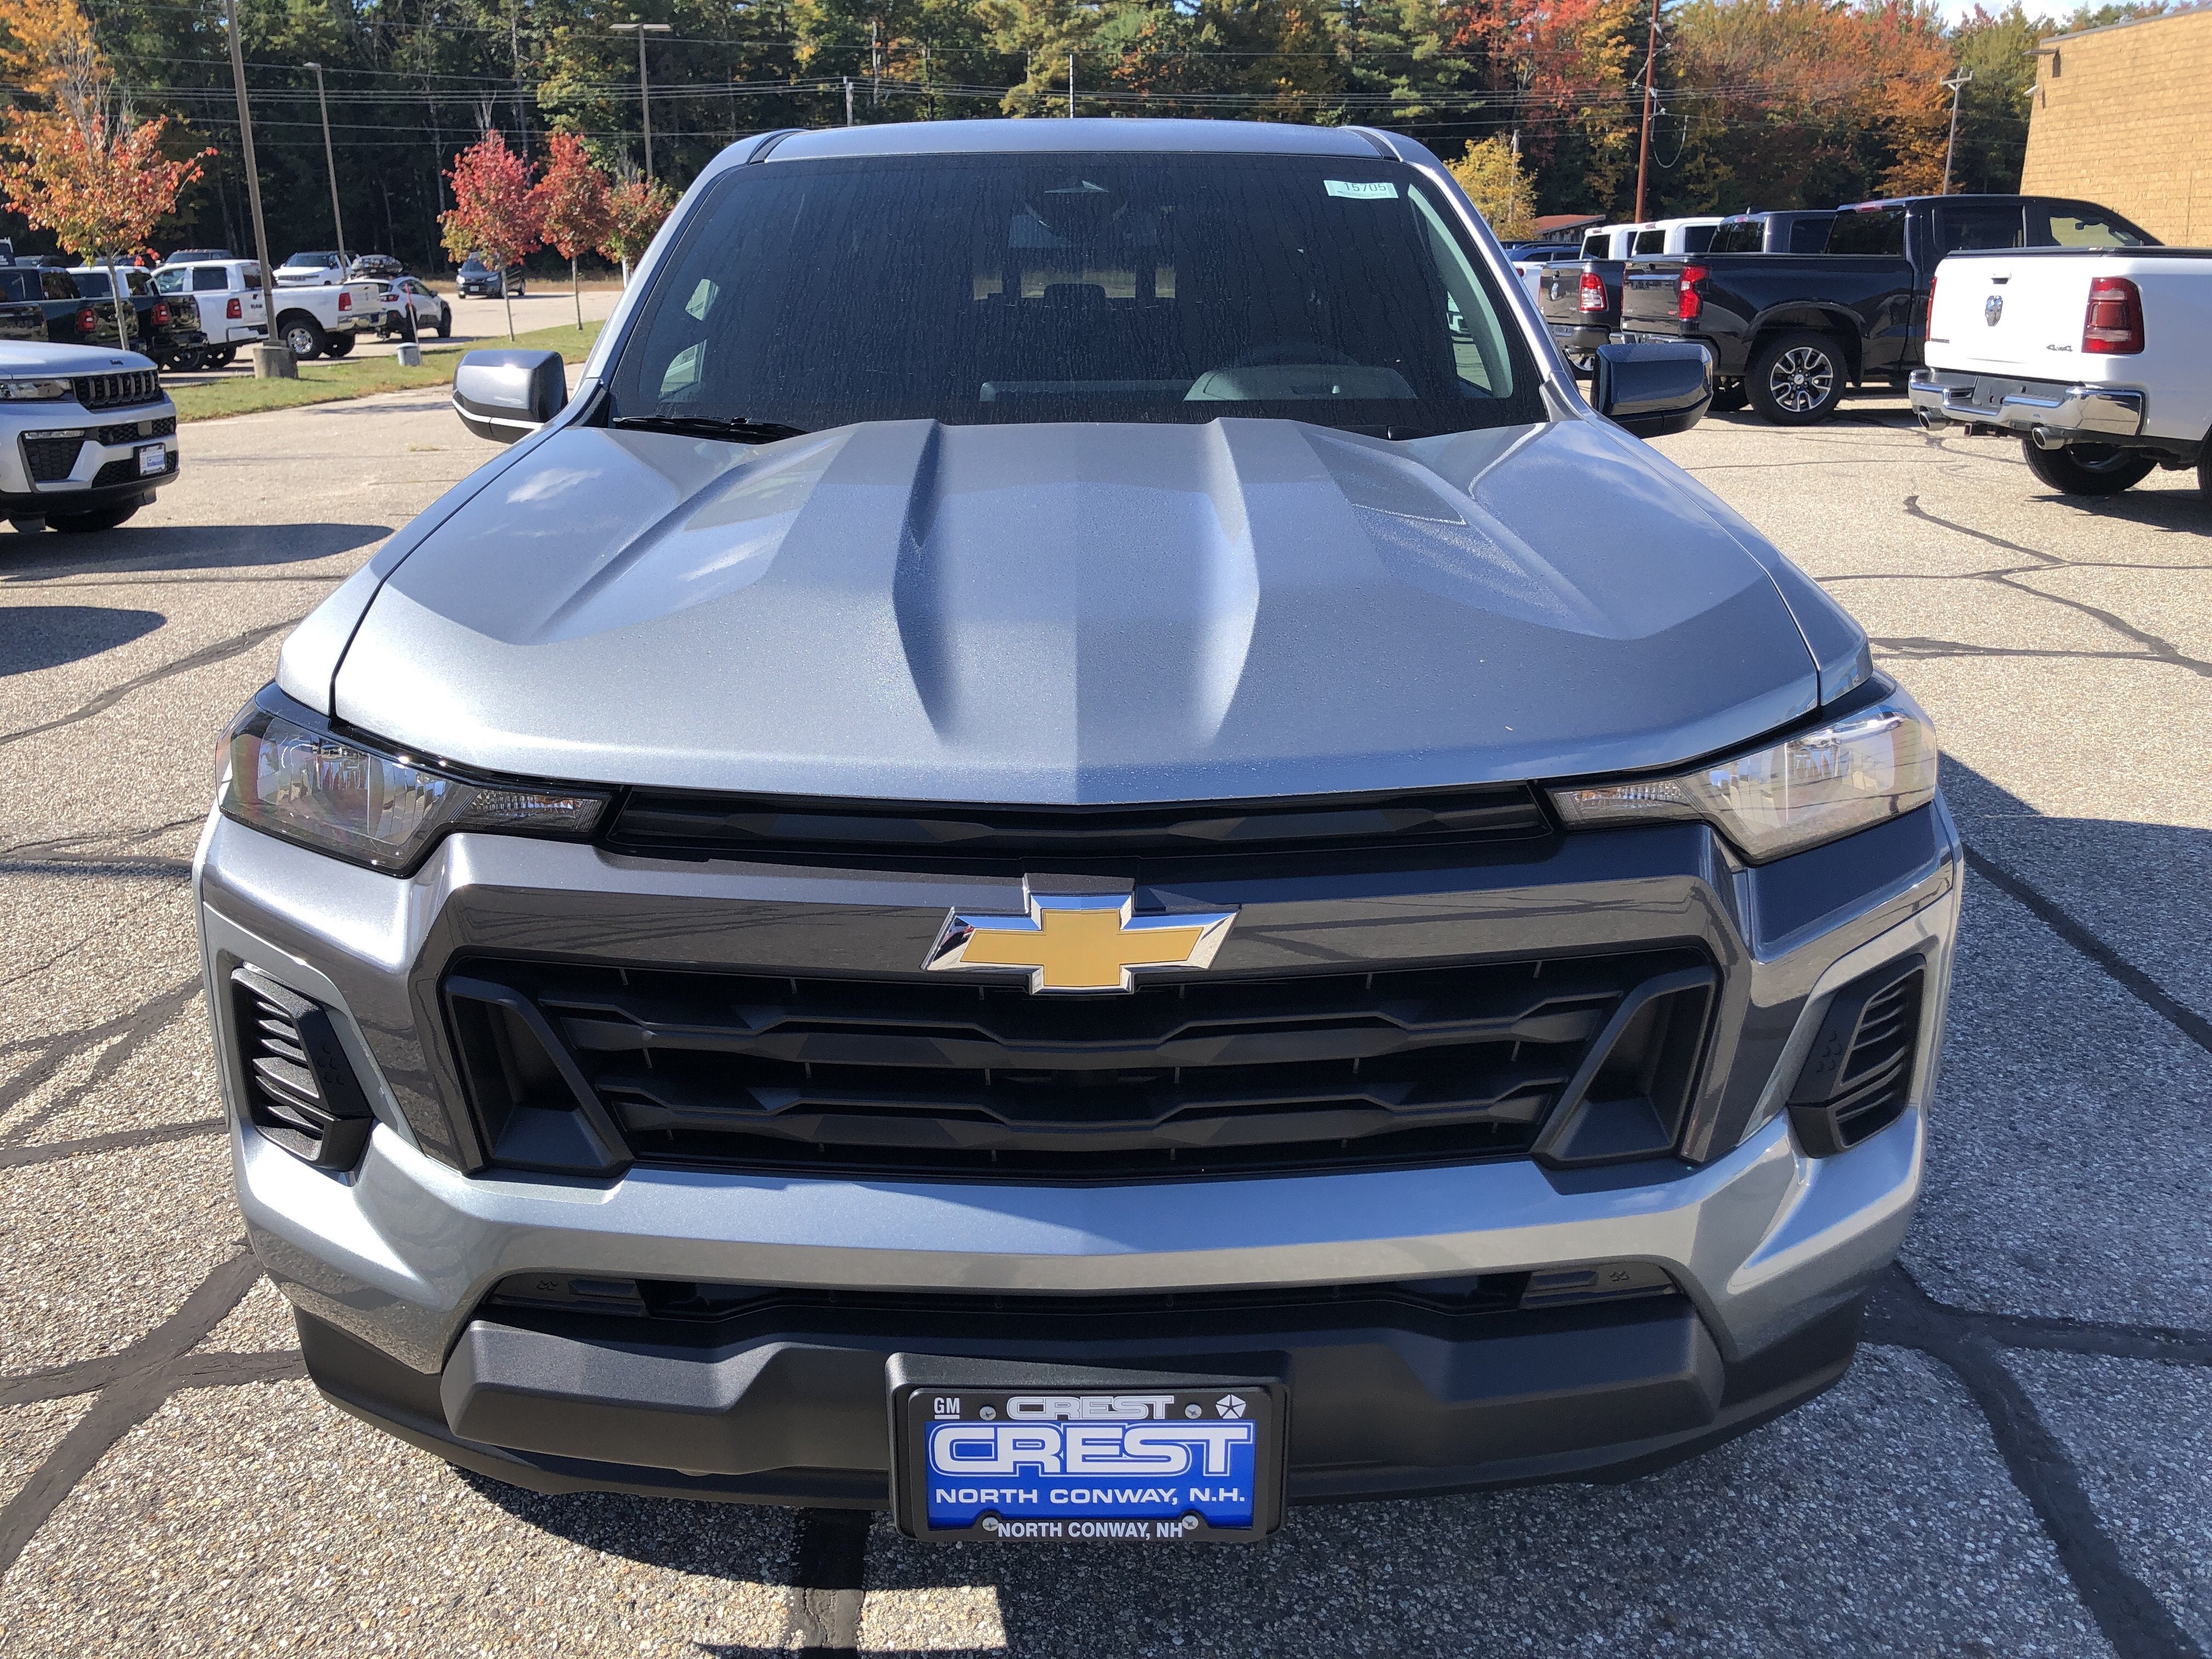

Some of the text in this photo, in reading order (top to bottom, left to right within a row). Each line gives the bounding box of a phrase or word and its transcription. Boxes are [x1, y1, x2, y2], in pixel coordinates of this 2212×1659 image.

[1344, 182, 1386, 192] 15705
[934, 1397, 960, 1414] GM
[1007, 1395, 1175, 1420] CREST
[929, 1423, 1254, 1477] CREST
[935, 1487, 1245, 1505] NORTH CONWAY, N.H.
[998, 1522, 1182, 1541] NORTH CONWAY, NH
